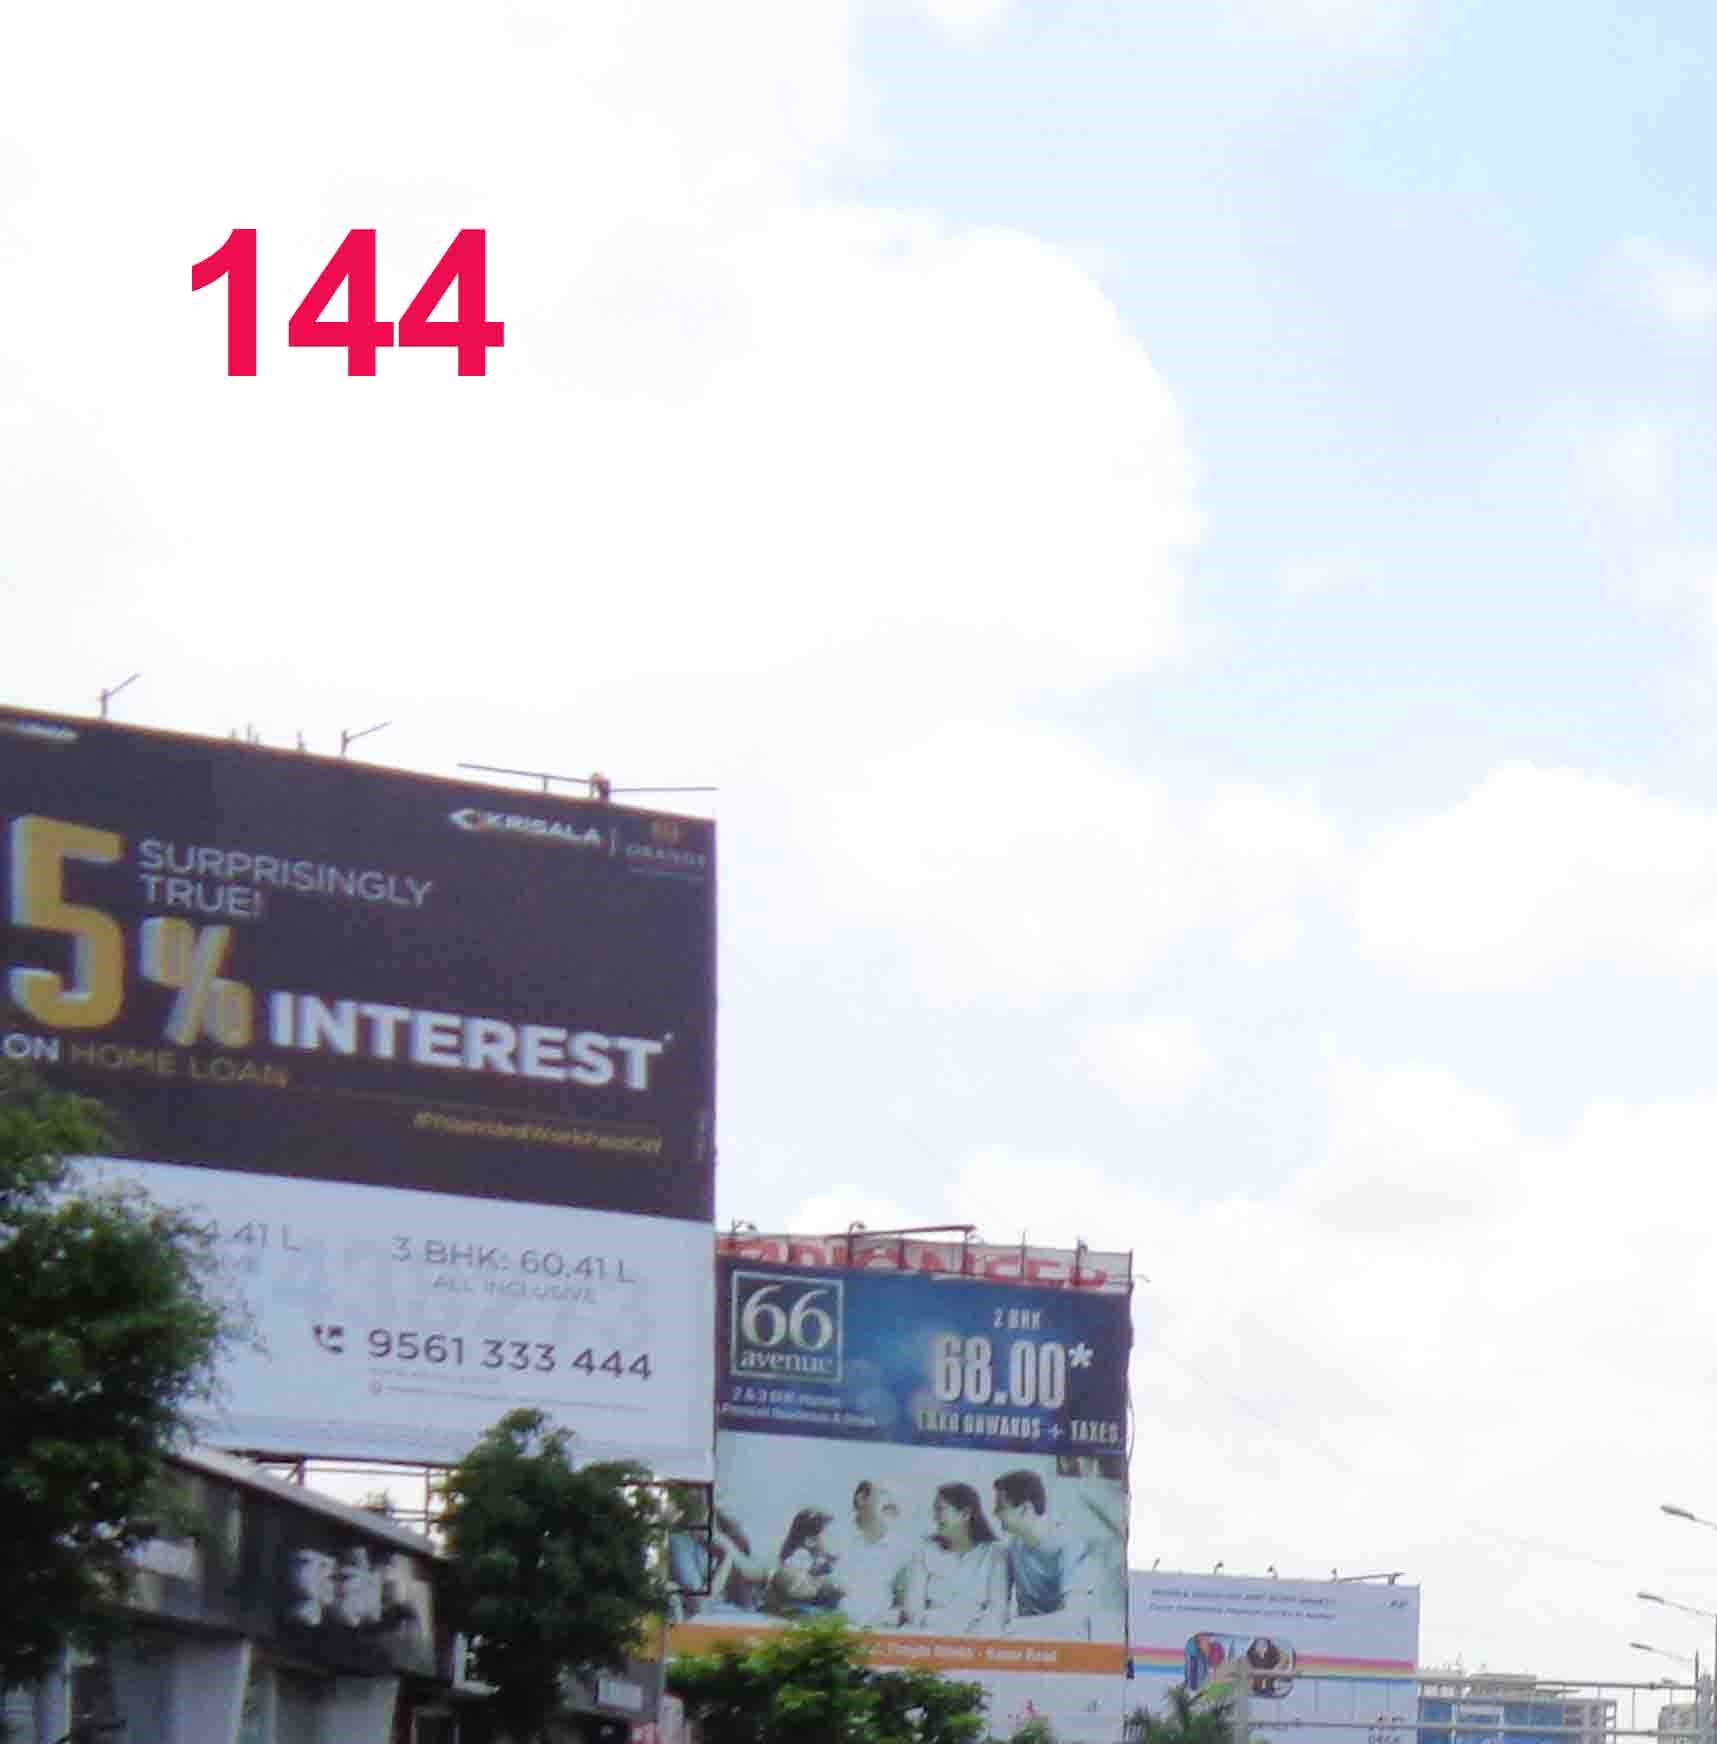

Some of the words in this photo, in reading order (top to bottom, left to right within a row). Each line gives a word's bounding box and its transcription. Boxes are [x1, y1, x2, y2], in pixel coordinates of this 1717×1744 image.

[139, 838, 433, 906] SURPRISINGLY
[140, 874, 263, 917] TRUE!
[2, 1031, 60, 1062] ON
[70, 1041, 177, 1078] HOME
[188, 1055, 290, 1089] LOAN
[392, 1236, 412, 1263] 3
[424, 1238, 508, 1271] BHK:
[519, 1249, 607, 1280] 60.41
[616, 1260, 637, 1284] L
[432, 1273, 474, 1292] ALL
[741, 1283, 834, 1351] 66
[993, 1307, 1004, 1329] 2
[367, 1327, 465, 1366] 9561
[480, 1337, 557, 1373] 333
[571, 1347, 654, 1382] 444
[740, 1350, 834, 1374] avenue
[963, 1413, 1041, 1439] ONWARDS
[1071, 1419, 1120, 1441] TAXES
